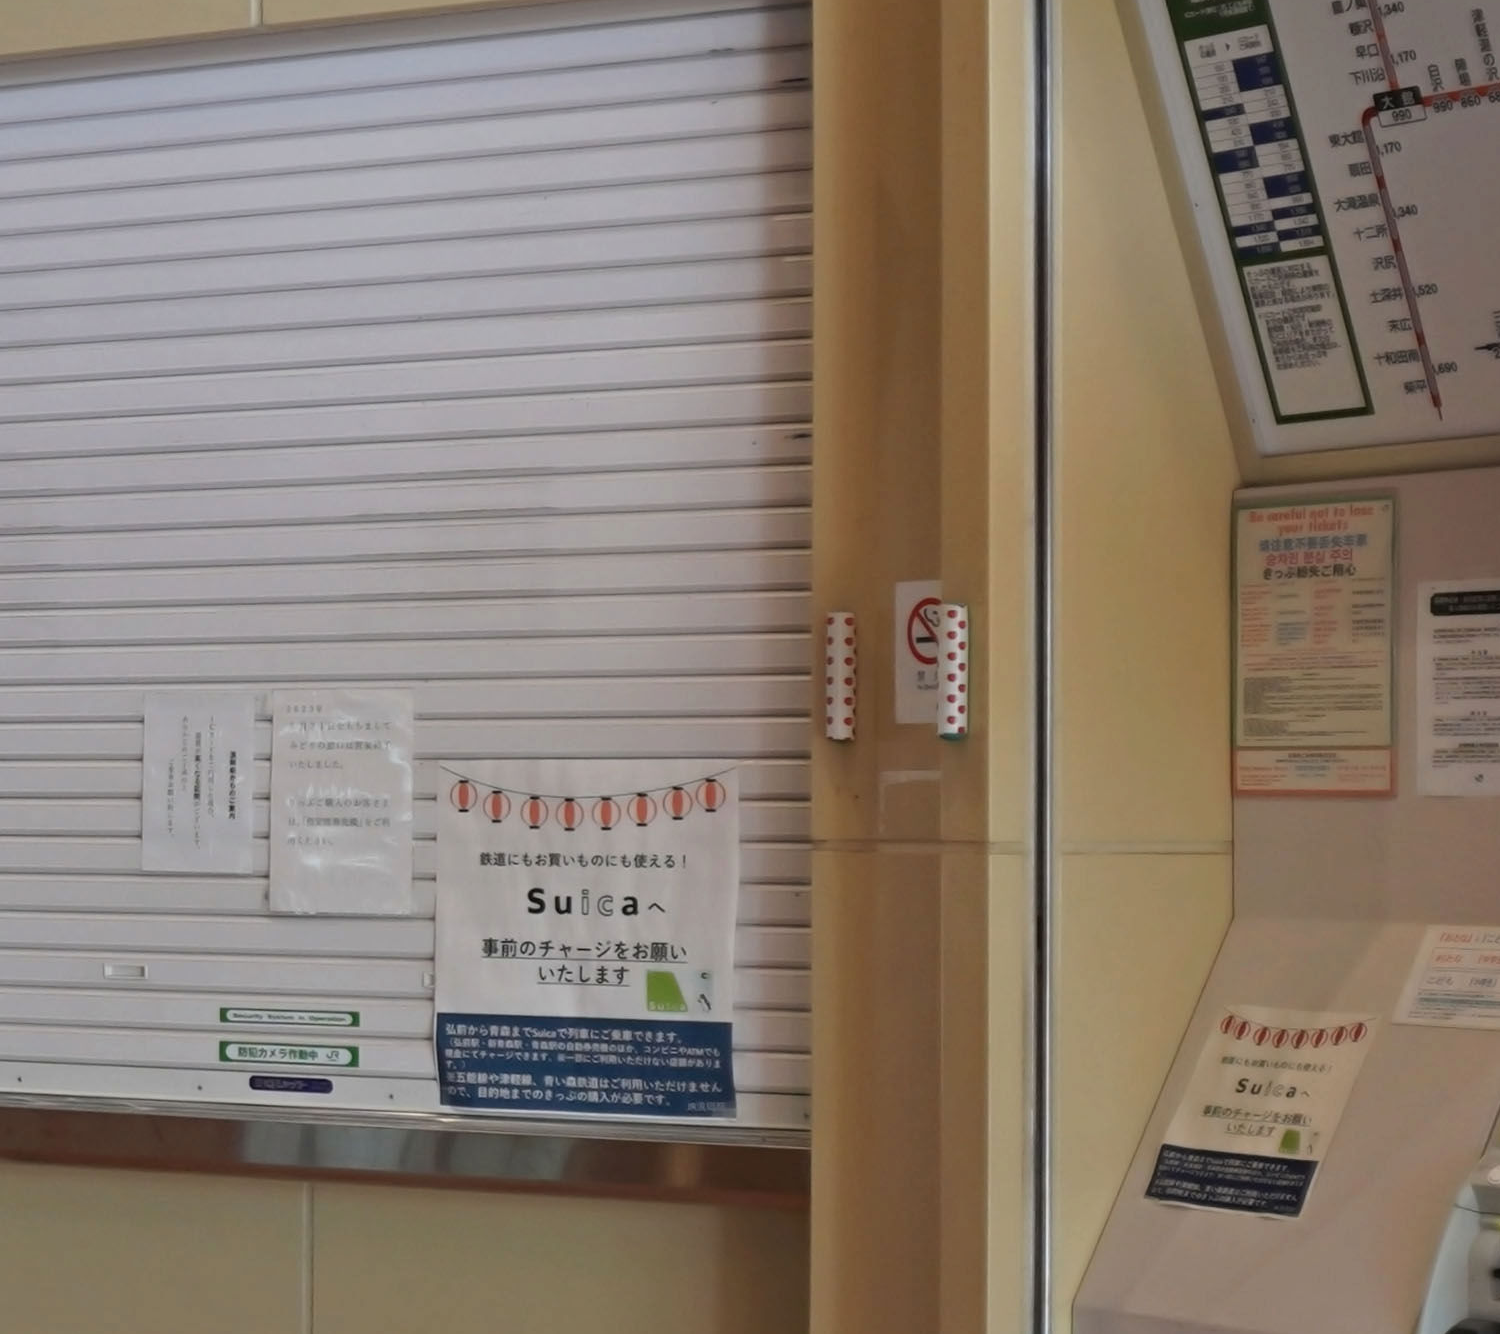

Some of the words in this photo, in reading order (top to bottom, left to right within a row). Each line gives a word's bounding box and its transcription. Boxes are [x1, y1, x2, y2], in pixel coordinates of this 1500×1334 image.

[1267, 508, 1306, 522] careful
[1333, 507, 1345, 518] to
[1350, 504, 1373, 517] lose
[1308, 520, 1348, 532] tickets
[480, 852, 688, 868] 鉄道にもお買いものにも使える！
[527, 888, 666, 916] Suicaへ
[482, 938, 687, 961] 事前のチャージをお願い
[538, 965, 629, 984] いたします
[238, 1046, 318, 1060] 防犯カメラ作動中
